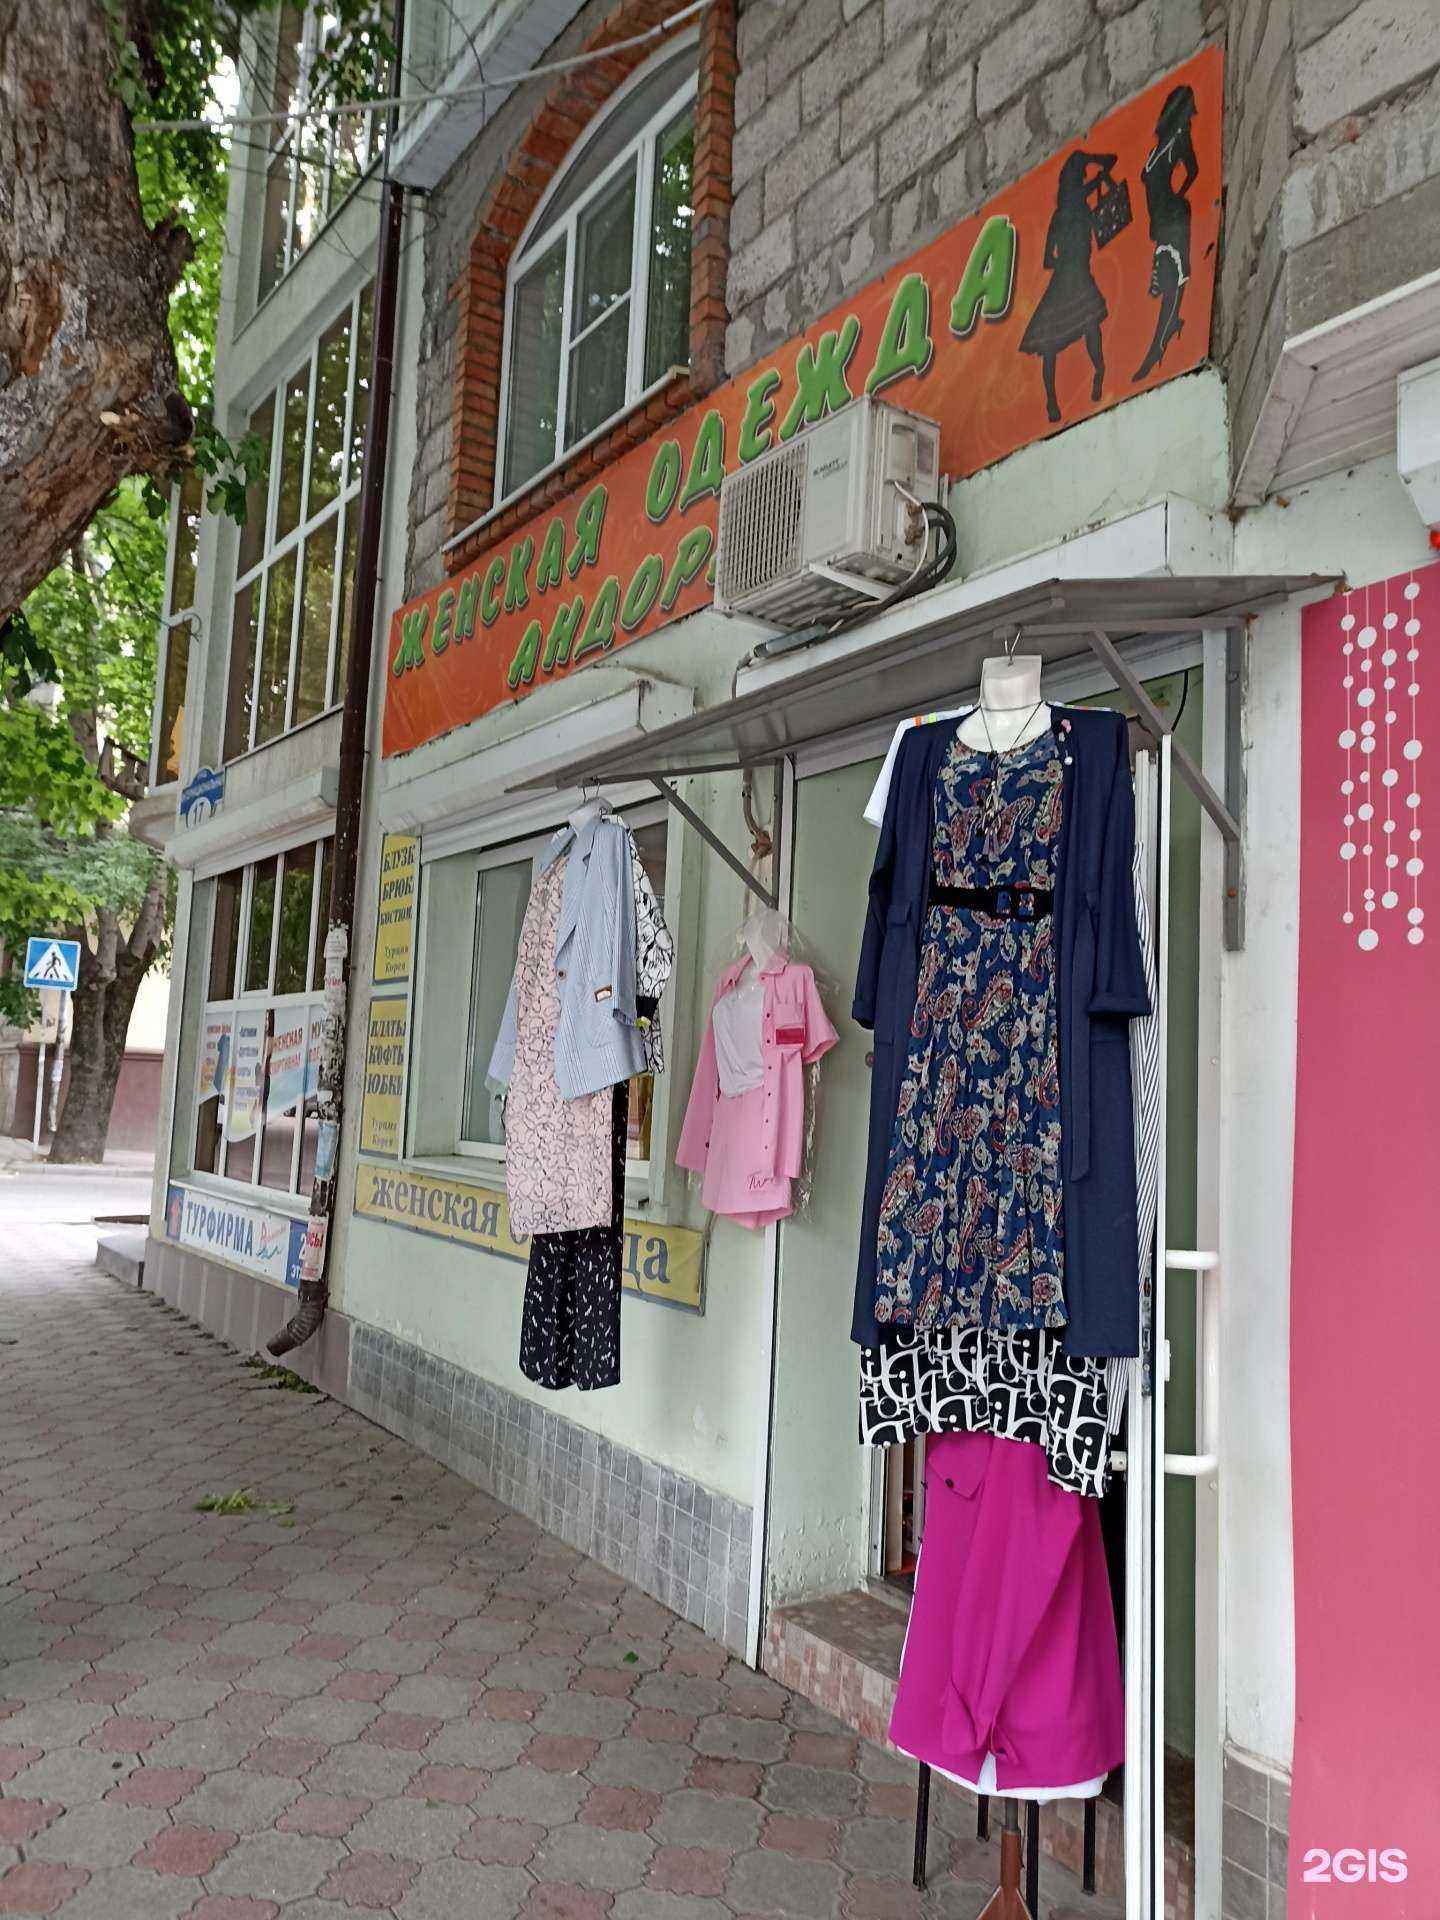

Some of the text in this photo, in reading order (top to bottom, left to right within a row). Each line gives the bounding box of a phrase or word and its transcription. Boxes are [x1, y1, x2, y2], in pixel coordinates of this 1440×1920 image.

[393, 214, 1017, 677] ЖЕНСКАЯ ОДЕЖДА
[186, 1200, 254, 1257] ТУРФИРМА
[371, 1175, 500, 1238] женская
